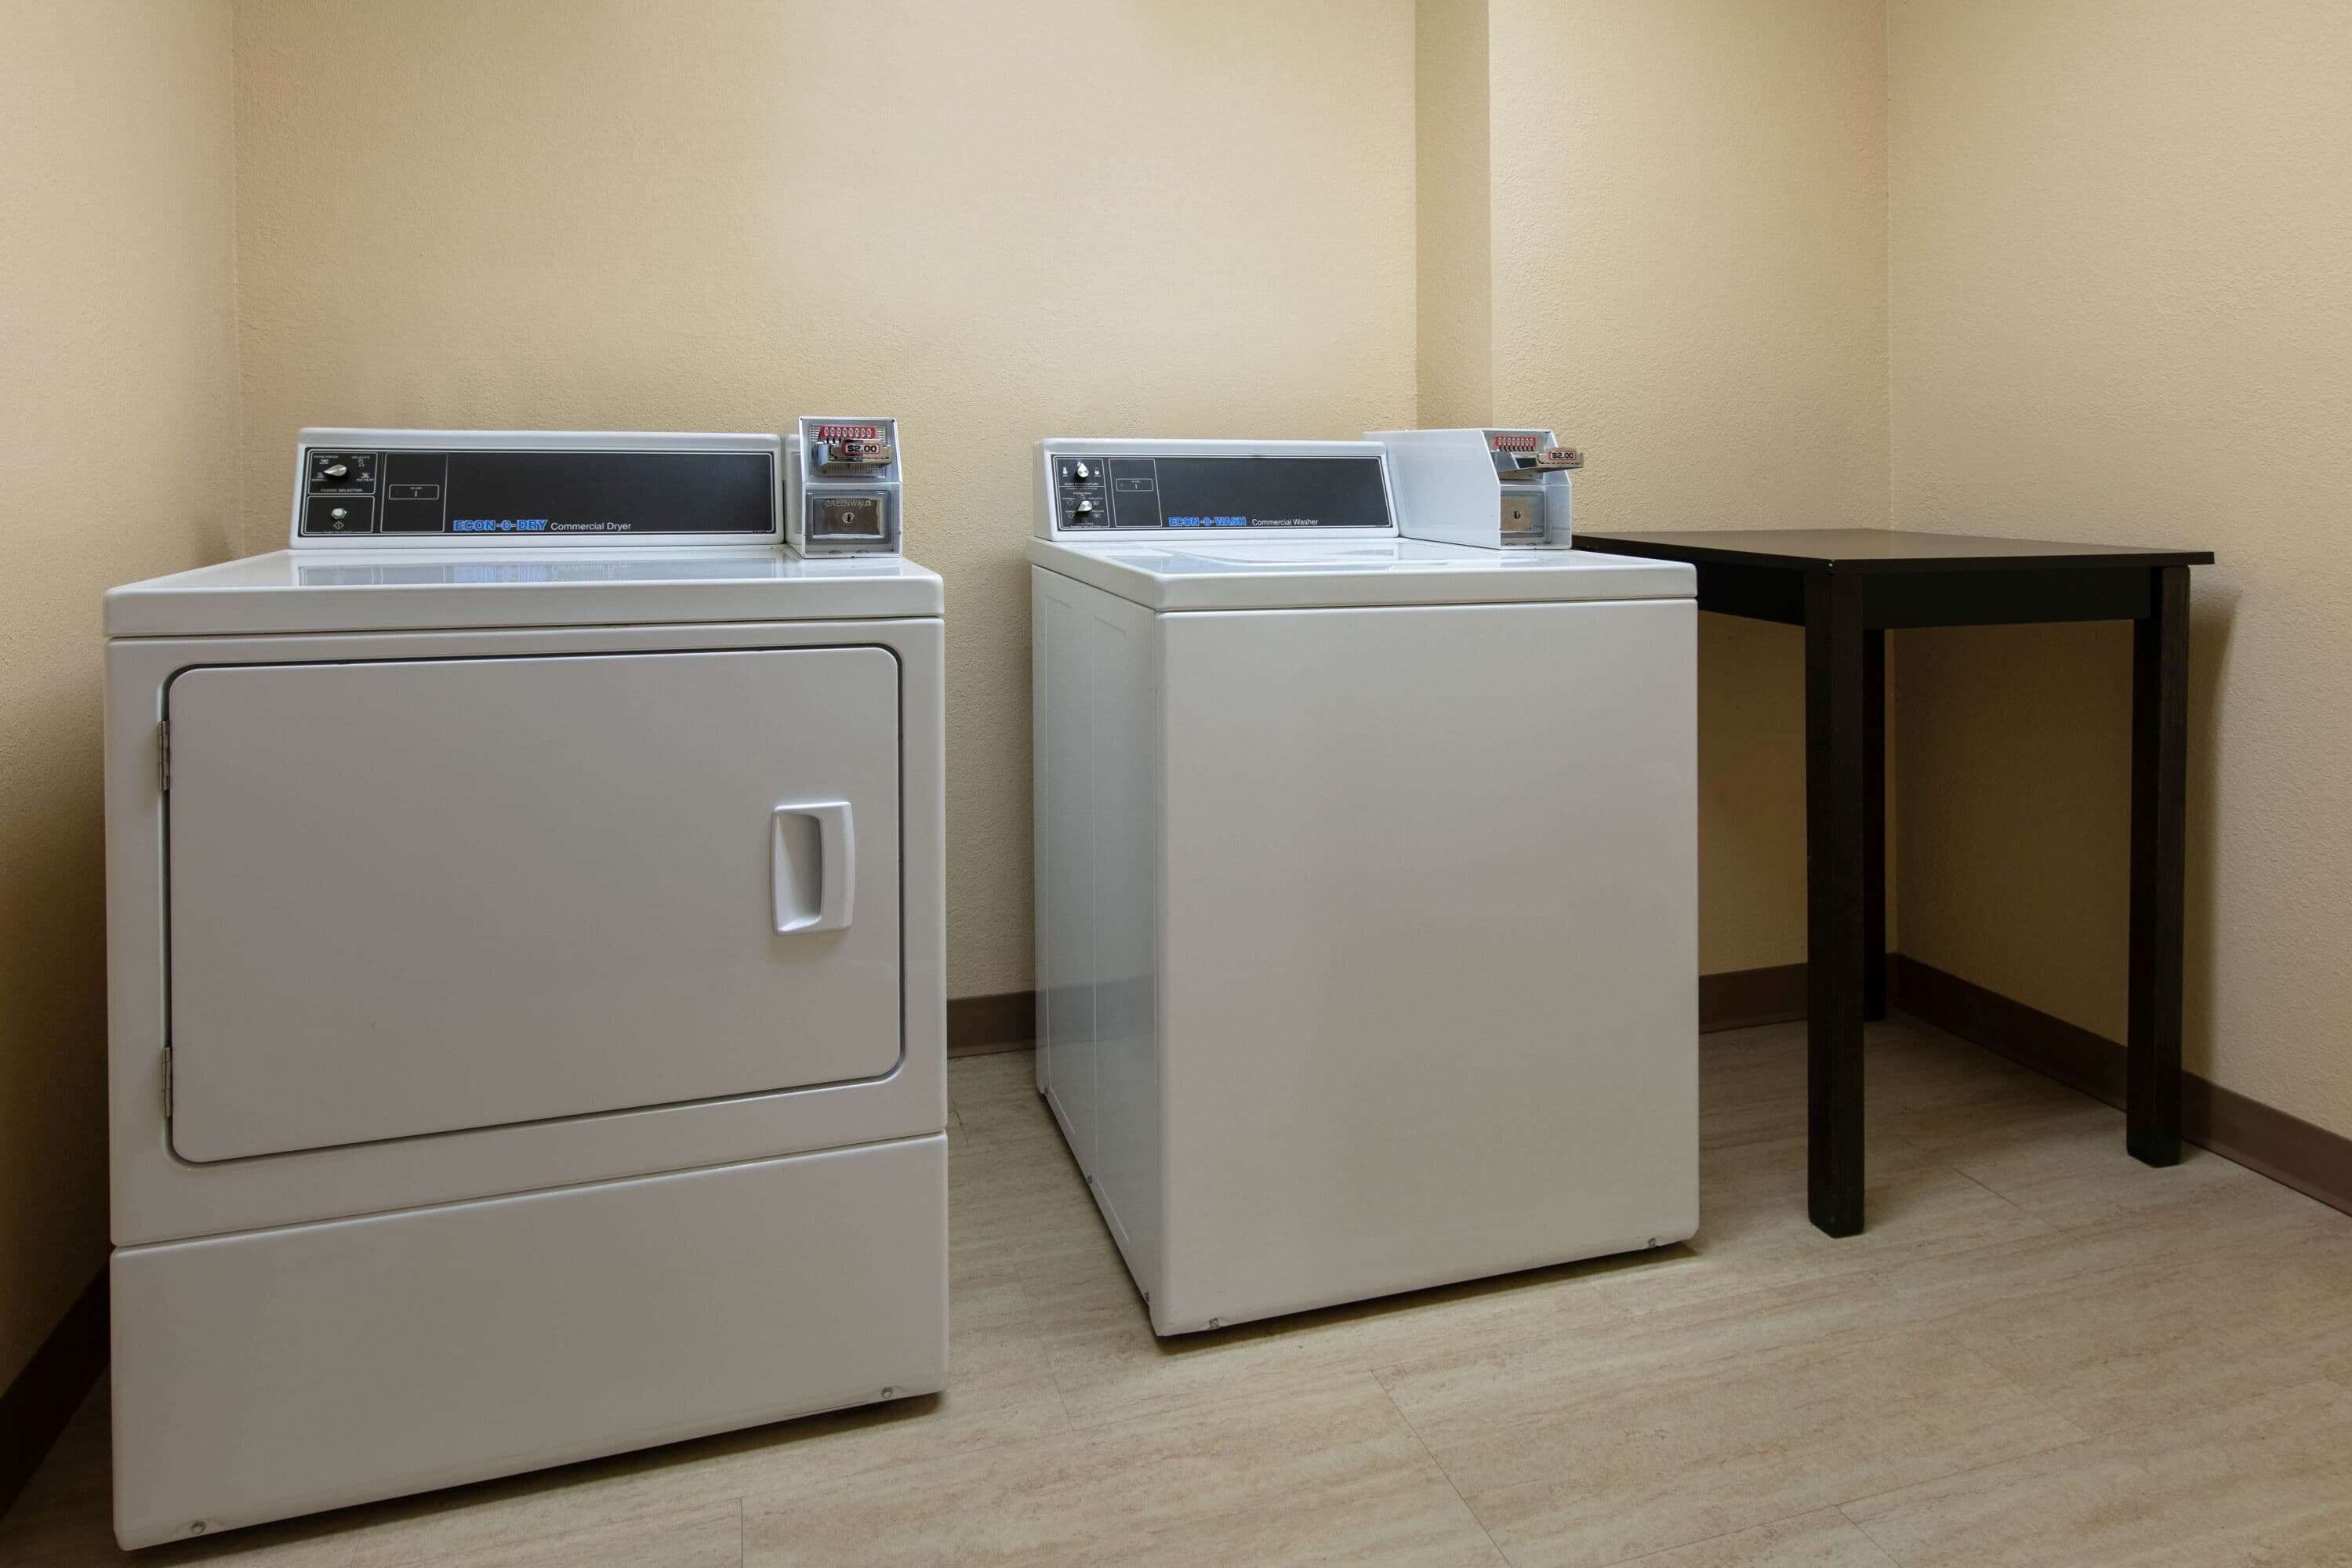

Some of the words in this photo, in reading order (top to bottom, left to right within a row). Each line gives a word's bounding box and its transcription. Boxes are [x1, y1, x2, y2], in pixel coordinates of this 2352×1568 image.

[452, 519, 548, 532] ECON-O-DRY
[550, 522, 604, 531] Commercial
[606, 522, 632, 532] Dryer
